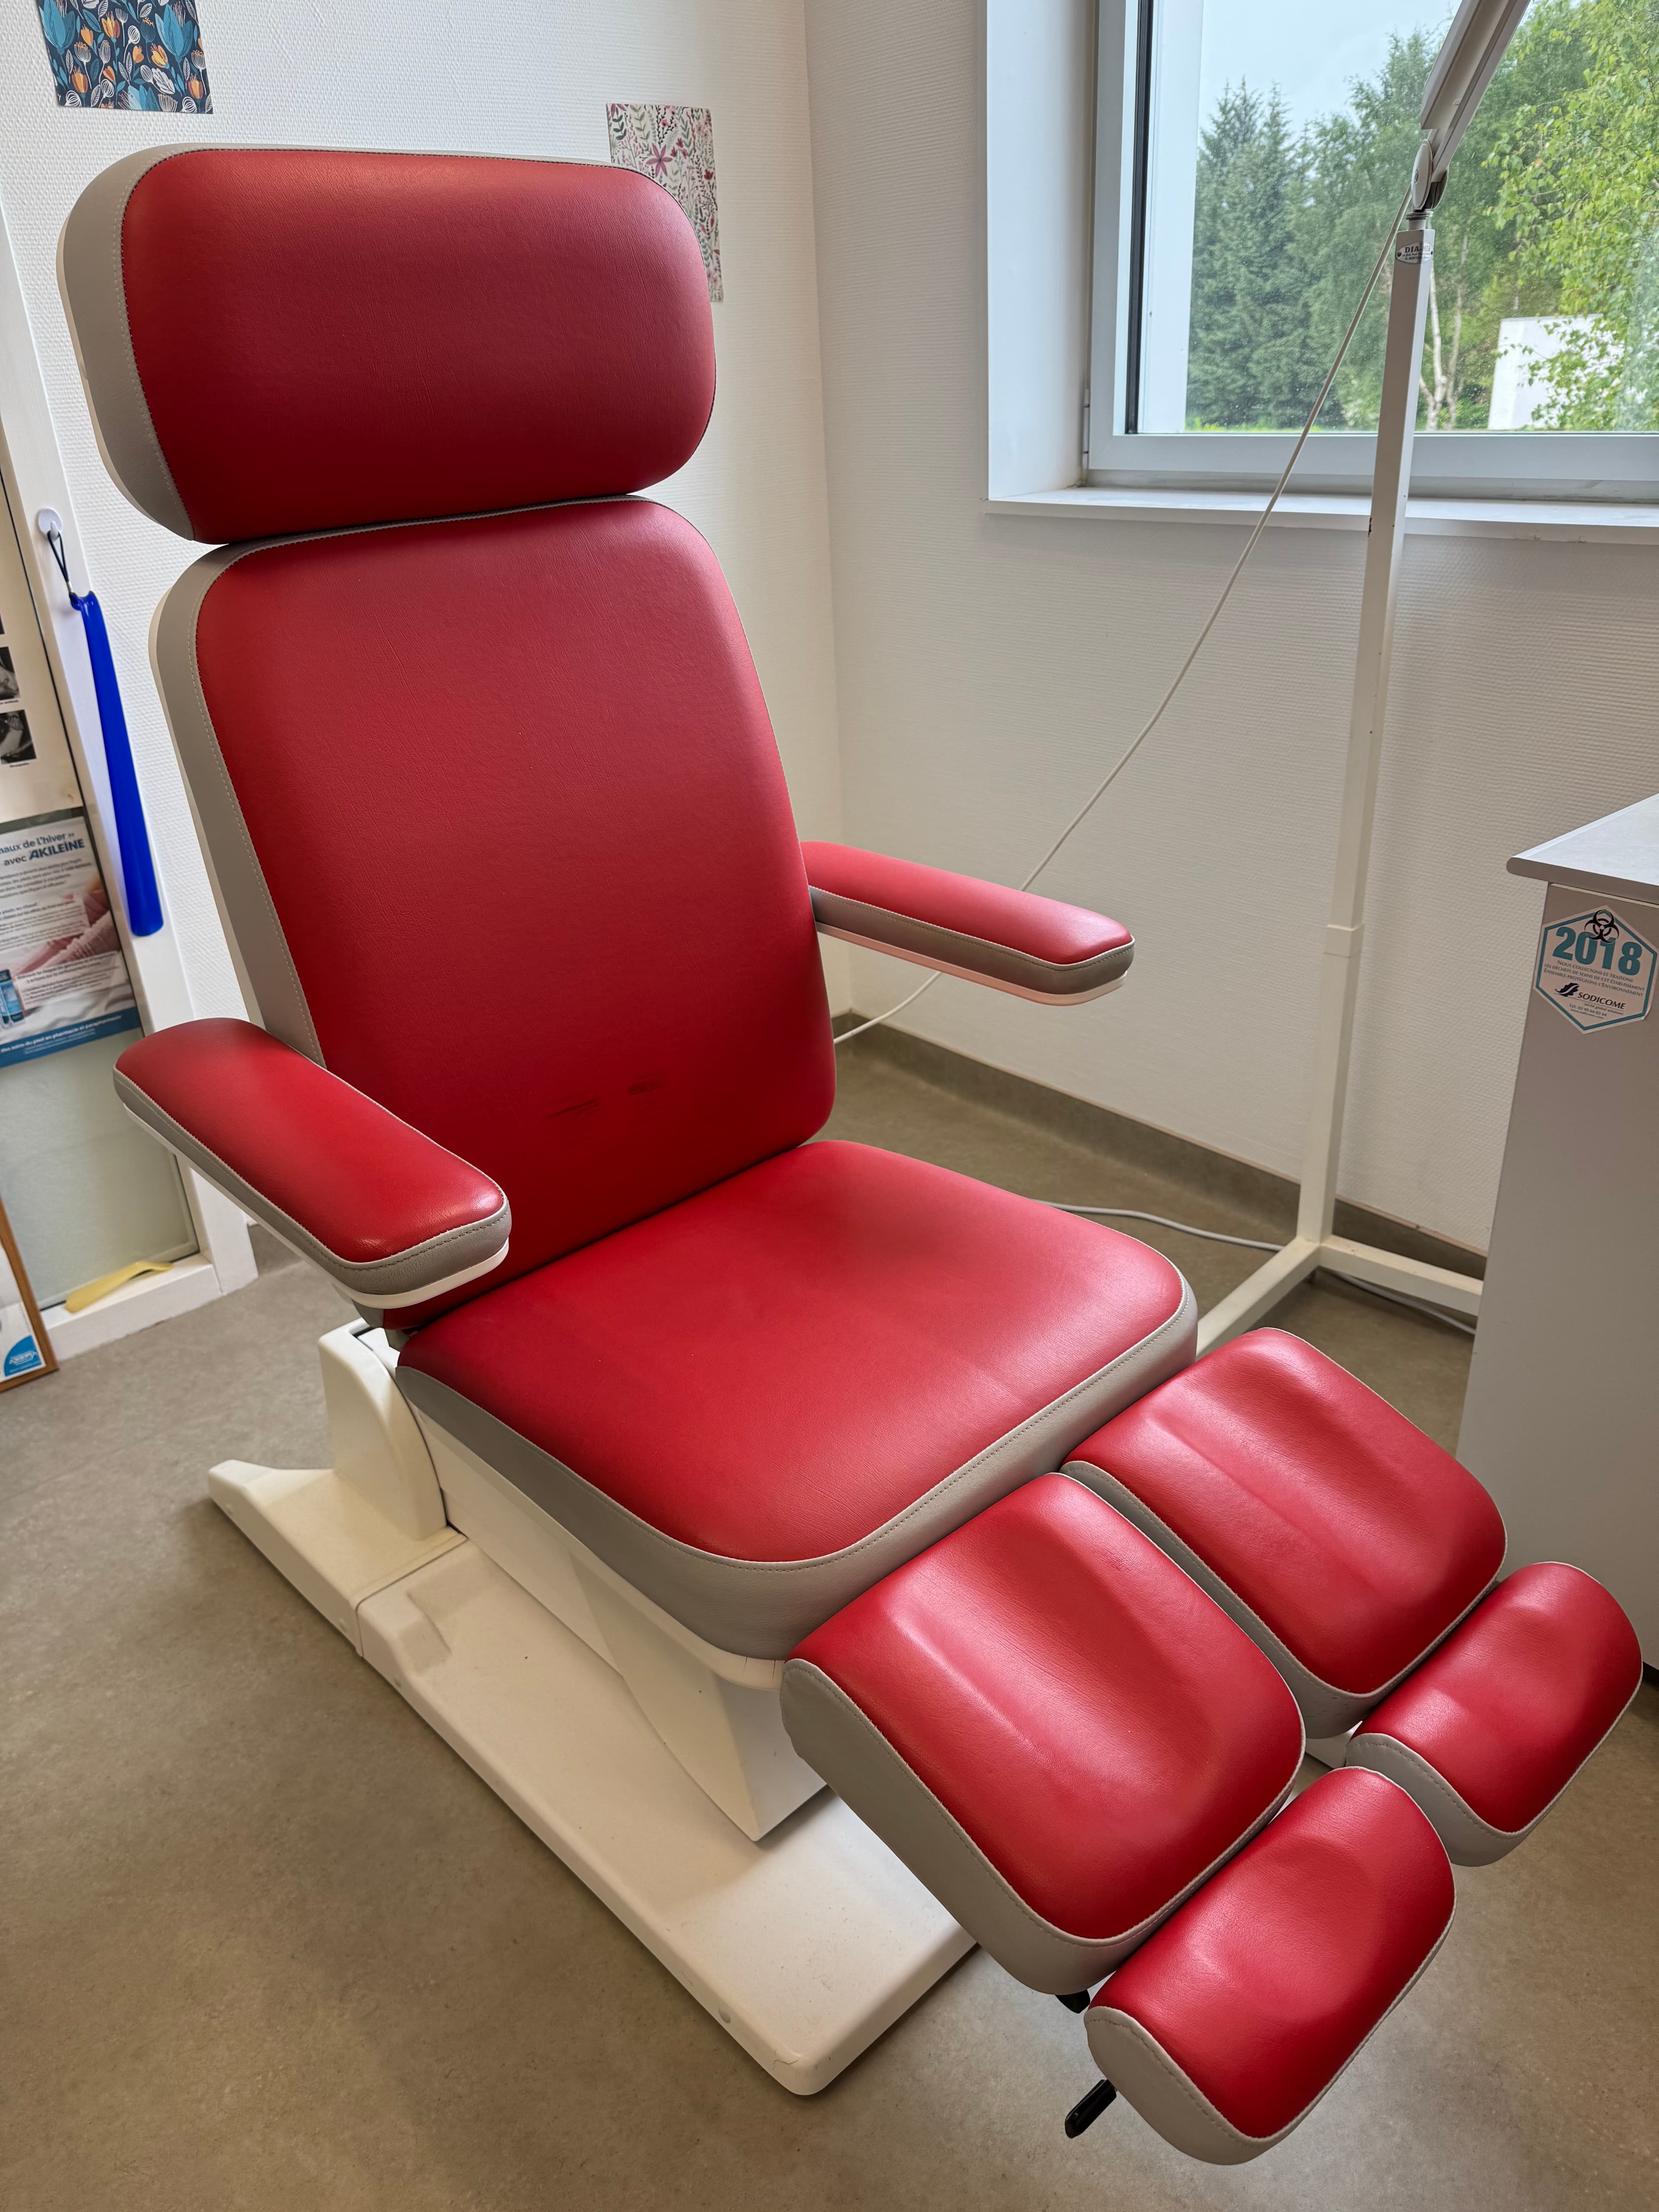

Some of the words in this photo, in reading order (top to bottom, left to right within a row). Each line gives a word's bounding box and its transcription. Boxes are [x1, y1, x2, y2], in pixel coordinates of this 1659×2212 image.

[23, 840, 35, 848] de
[37, 833, 66, 845] l'hiver
[4, 855, 27, 866] avec
[1552, 926, 1643, 976] 2018
[1544, 968, 1566, 977] ENSEMBLE
[1573, 964, 1602, 975] COLLECTONS
[1610, 974, 1633, 982] TRAITONS
[1578, 992, 1626, 1009] SODICOME
